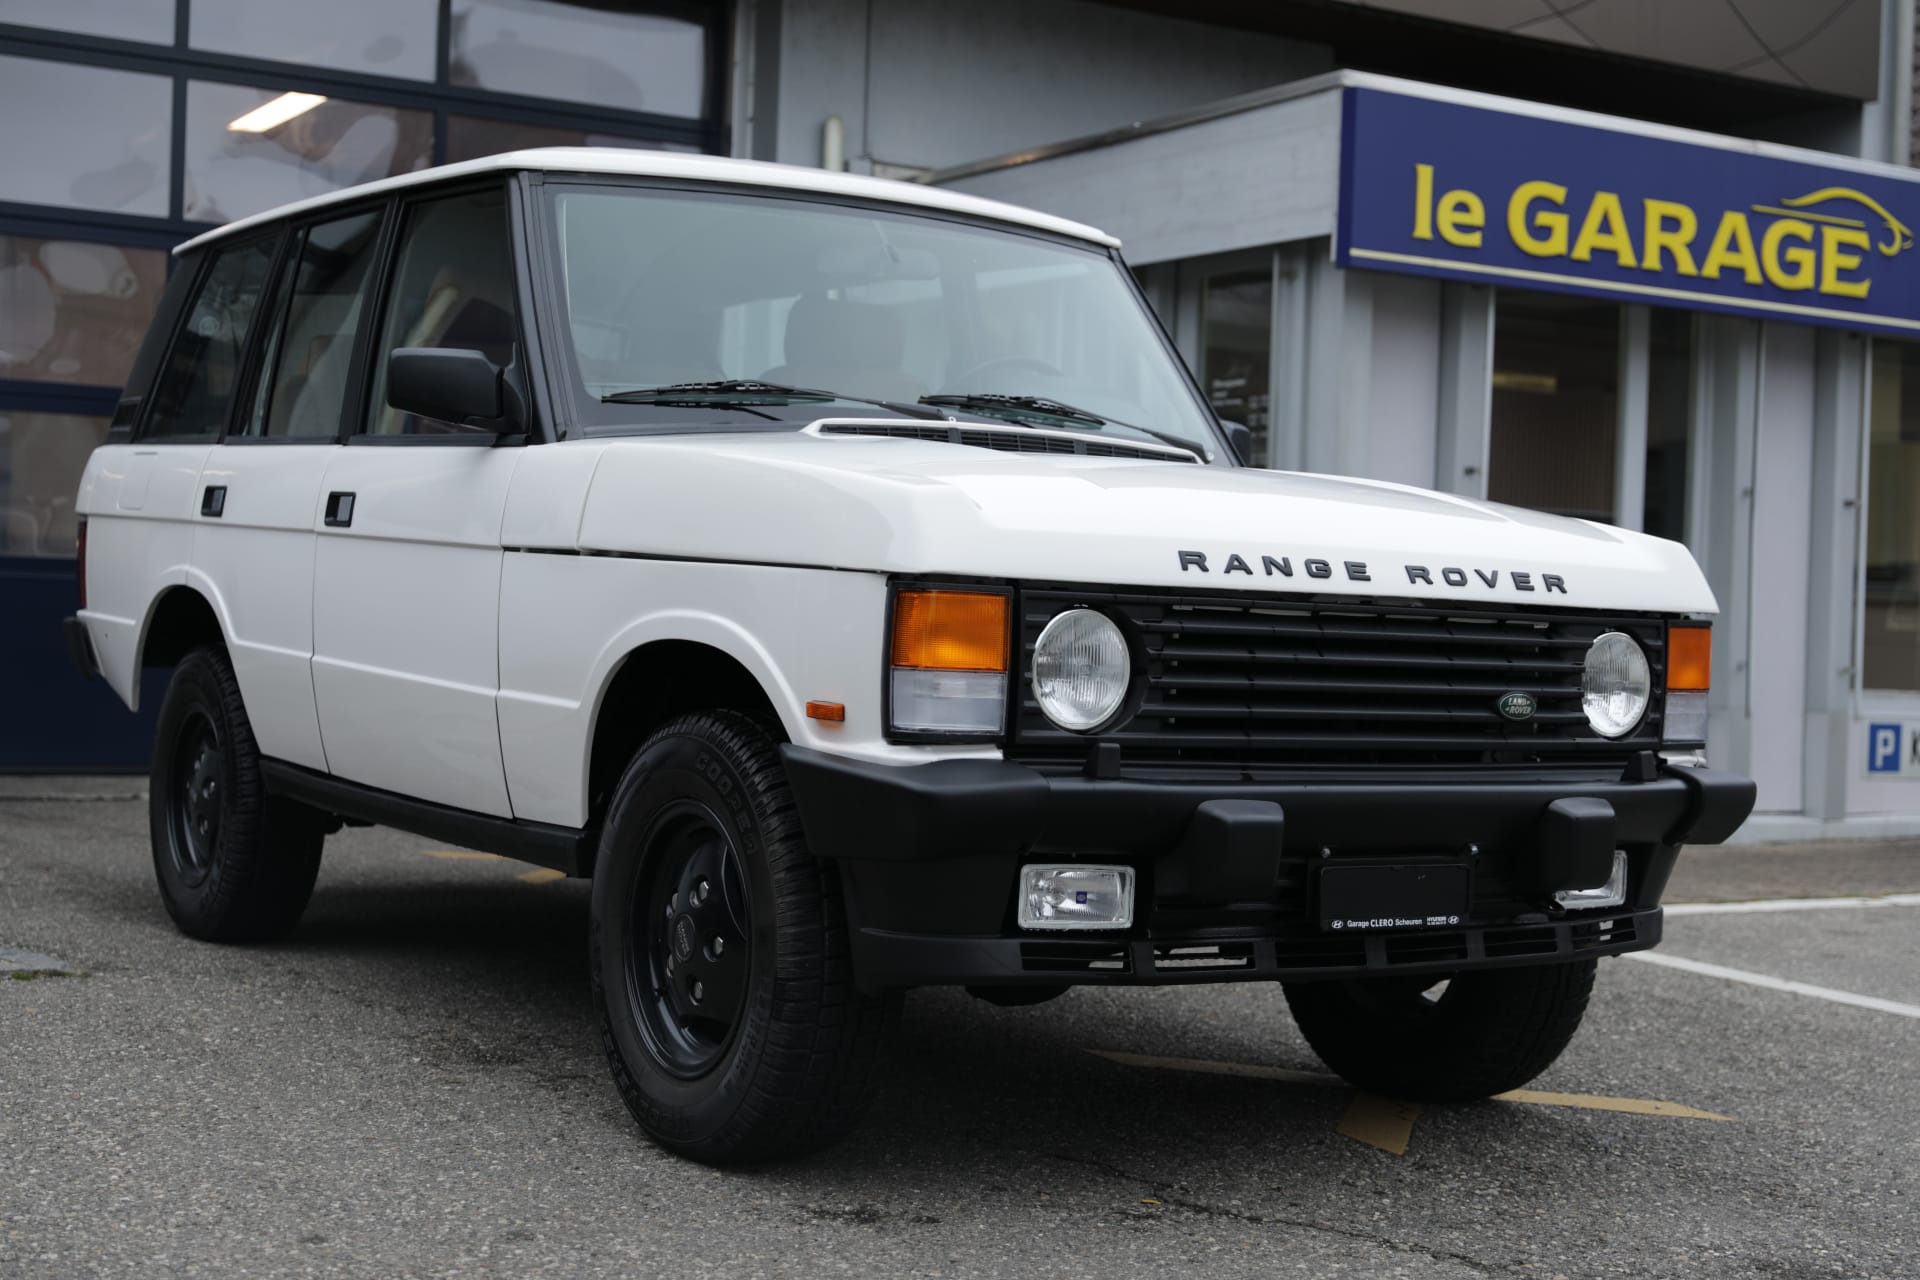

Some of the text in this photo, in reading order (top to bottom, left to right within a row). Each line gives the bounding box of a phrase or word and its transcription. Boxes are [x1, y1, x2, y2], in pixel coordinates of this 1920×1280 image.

[1412, 163, 1871, 298] le GARAGE
[1178, 550, 1567, 594] RANGE ROVER
[1508, 697, 1527, 706] LAND
[1508, 706, 1532, 714] ROVER
[1875, 728, 1896, 769] P
[1347, 920, 1369, 929] Garage
[1370, 918, 1393, 927] CLERO
[1395, 918, 1422, 926] Scheuren
